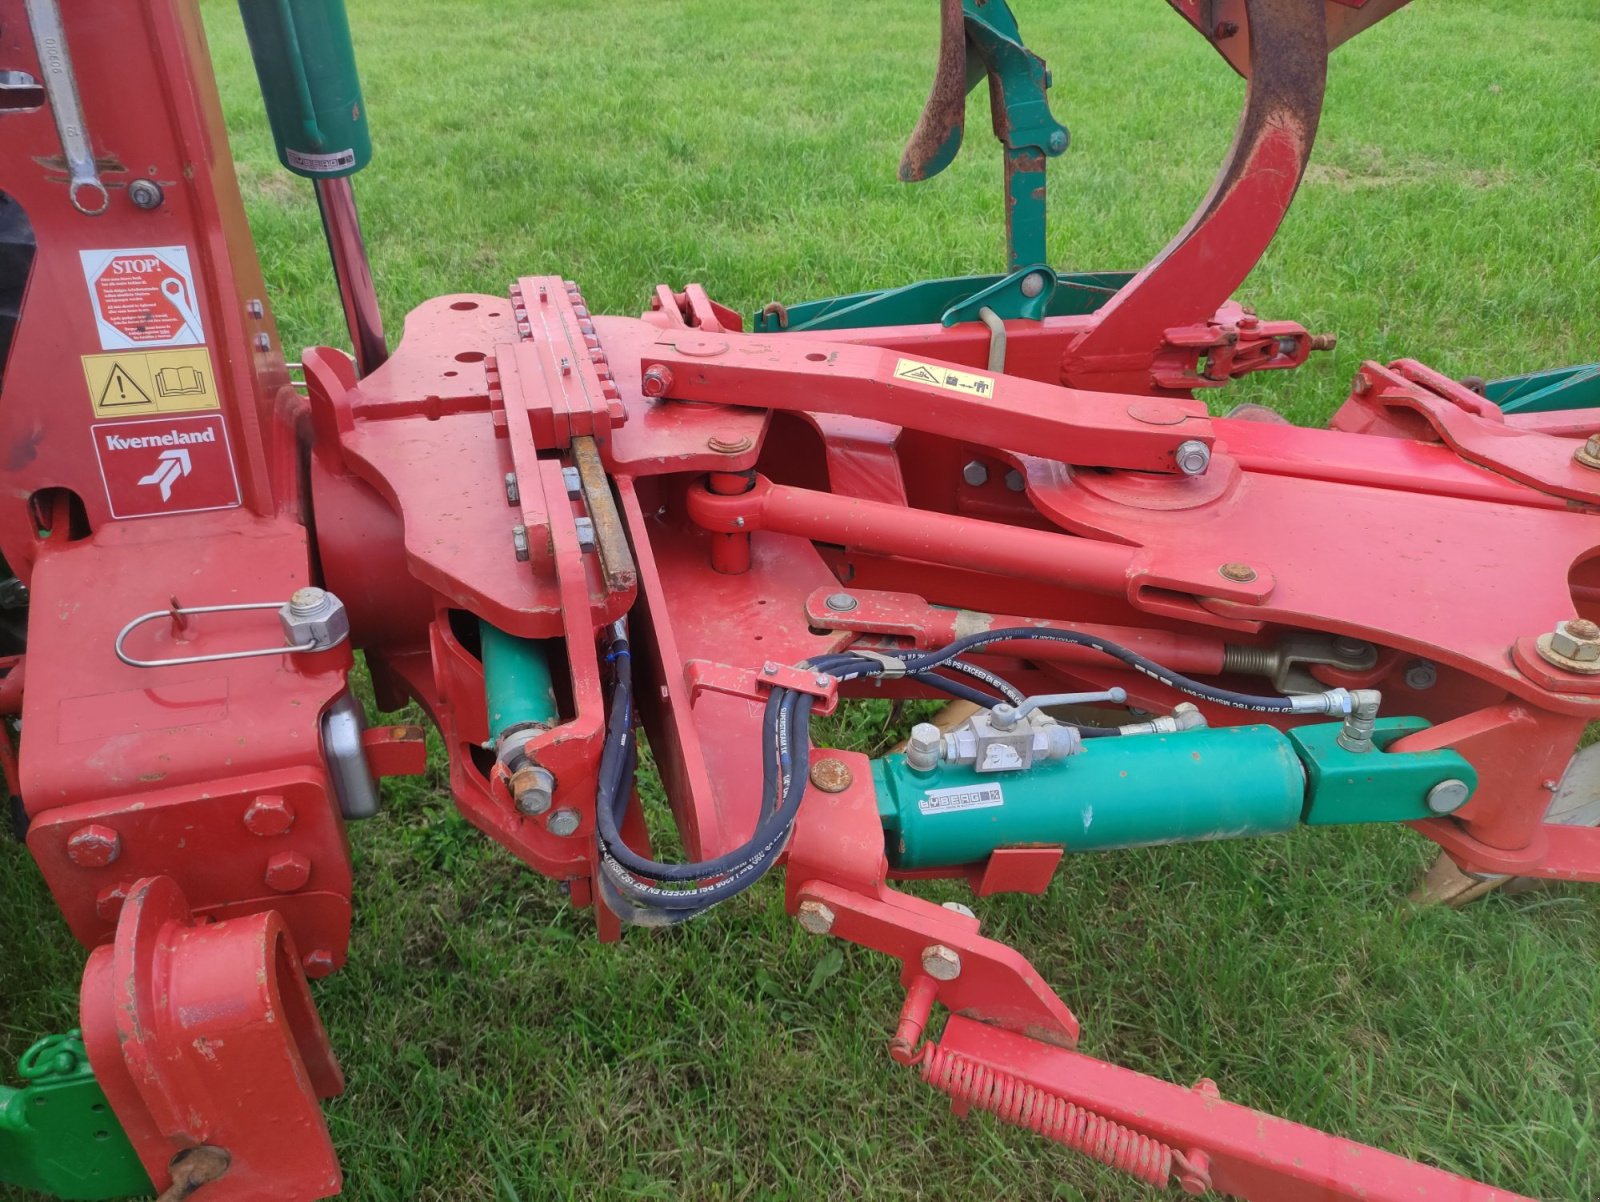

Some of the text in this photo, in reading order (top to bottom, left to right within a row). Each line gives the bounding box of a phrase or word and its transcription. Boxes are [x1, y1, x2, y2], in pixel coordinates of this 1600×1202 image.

[112, 258, 161, 275] STOP!
[106, 427, 215, 452] Kverneland
[963, 664, 987, 680] EXCEED
[660, 888, 698, 898] EXCEED
